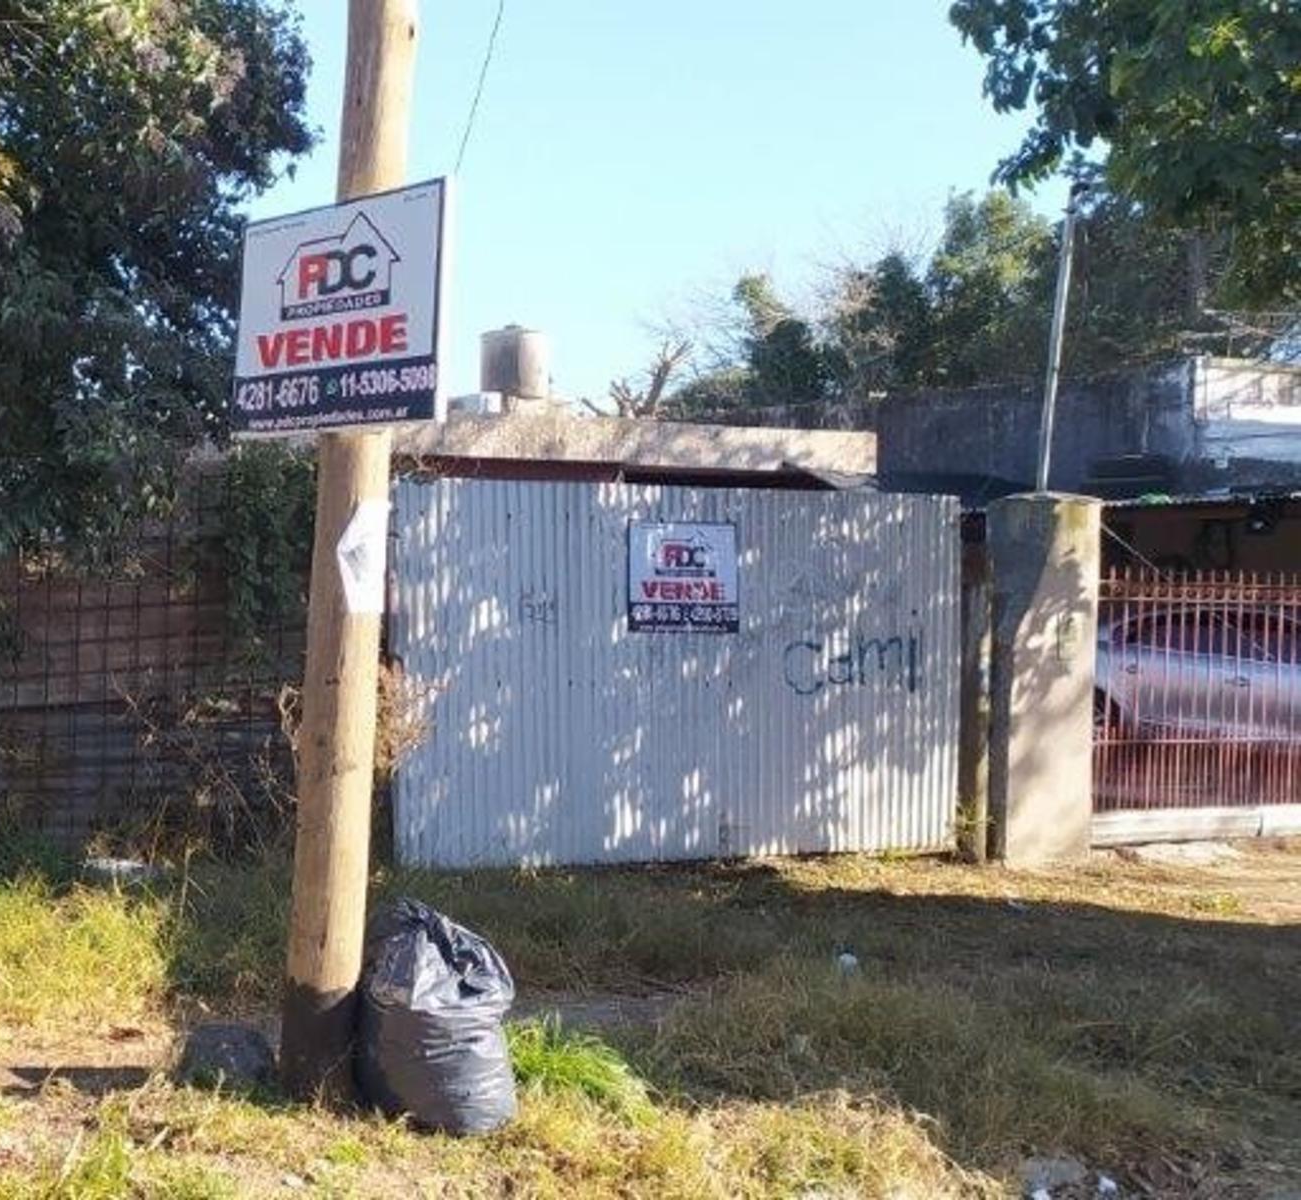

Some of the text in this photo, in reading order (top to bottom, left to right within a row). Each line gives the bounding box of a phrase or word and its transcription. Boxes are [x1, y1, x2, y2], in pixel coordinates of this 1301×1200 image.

[298, 244, 377, 299] PDC
[286, 292, 382, 319] PROPIEDADES
[257, 313, 407, 369] VENDE
[236, 376, 319, 411] 4281-6676
[642, 580, 725, 601] VENDE
